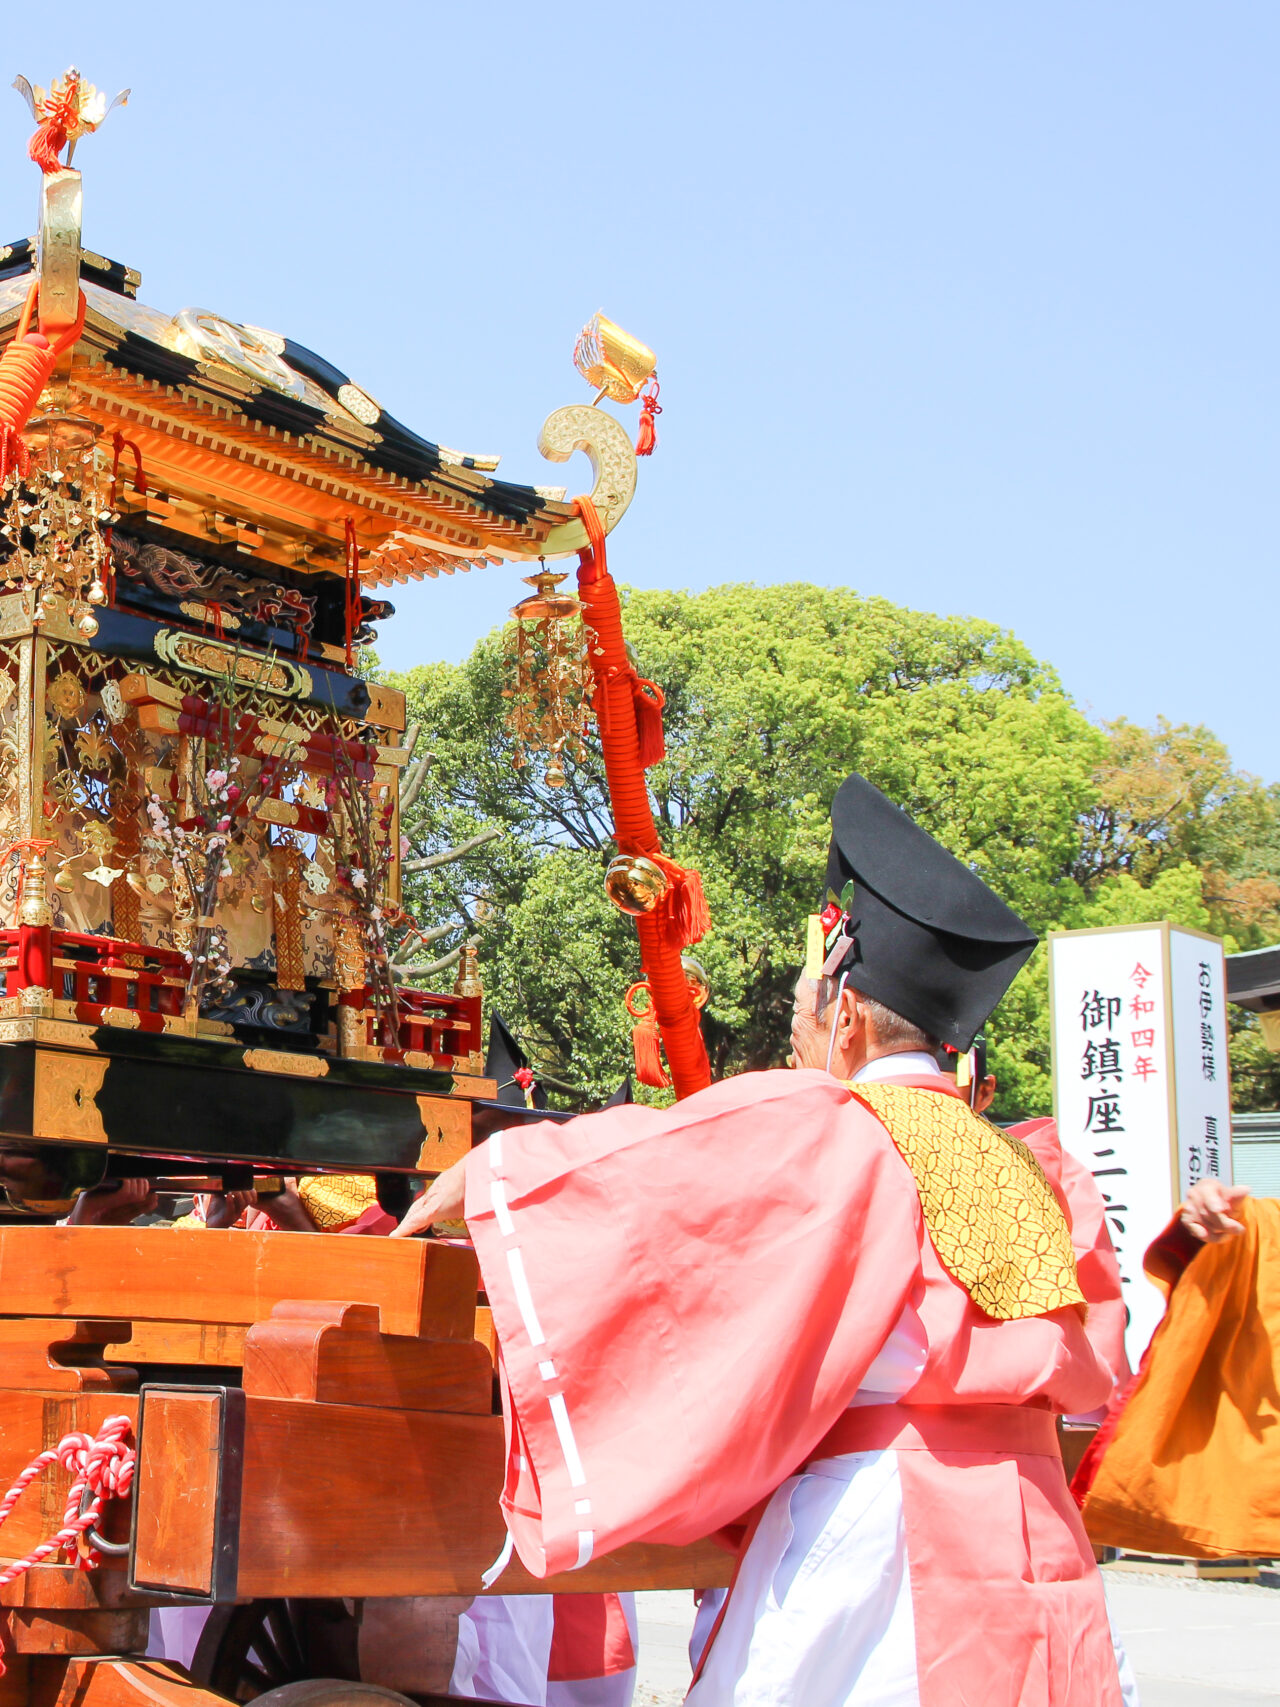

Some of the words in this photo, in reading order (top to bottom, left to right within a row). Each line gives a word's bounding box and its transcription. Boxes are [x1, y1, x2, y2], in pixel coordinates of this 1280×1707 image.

[1129, 962, 1158, 1081] 令和四年
[1198, 961, 1217, 1082] お伊勢様
